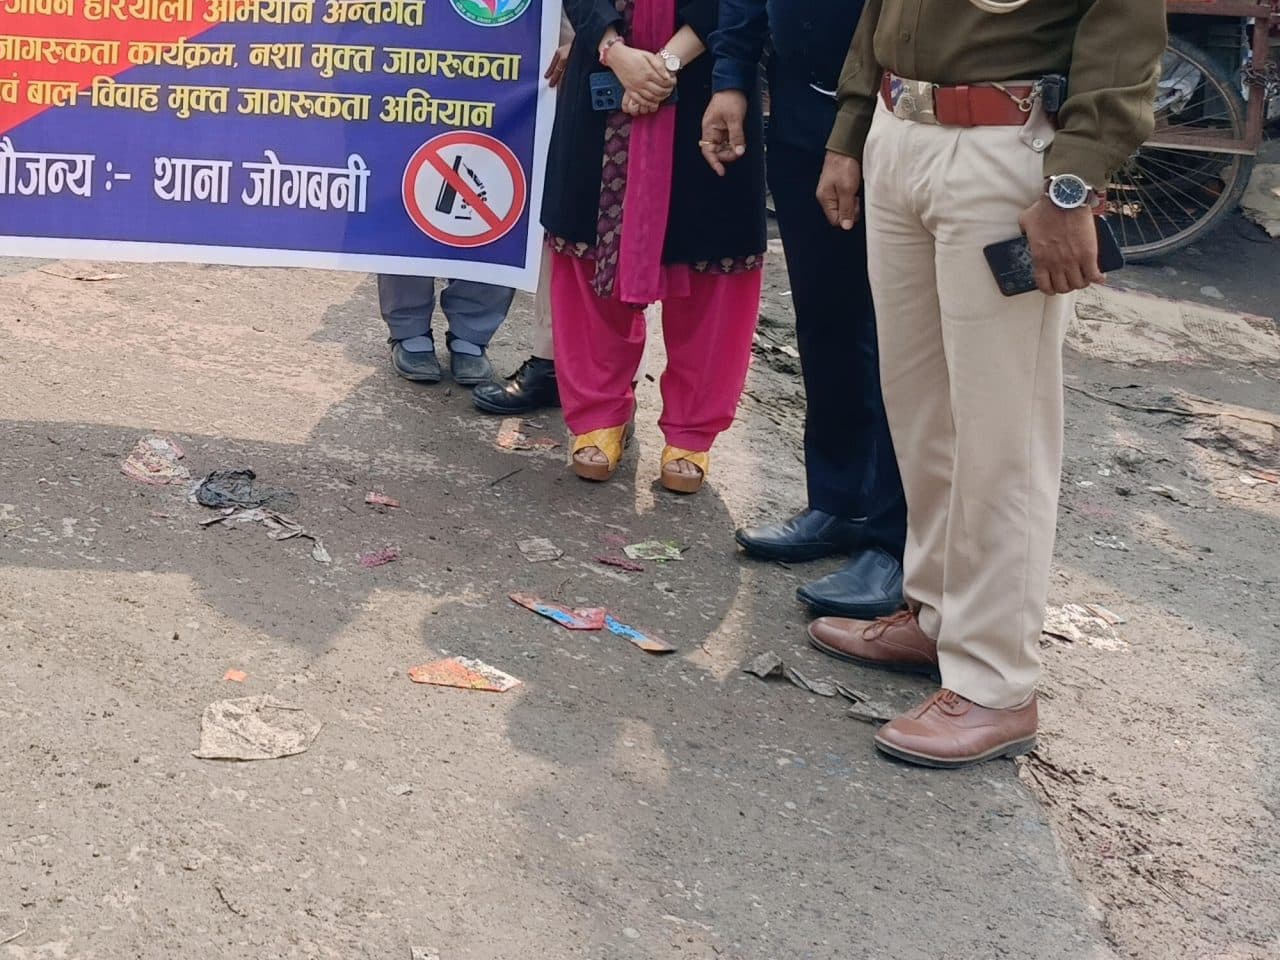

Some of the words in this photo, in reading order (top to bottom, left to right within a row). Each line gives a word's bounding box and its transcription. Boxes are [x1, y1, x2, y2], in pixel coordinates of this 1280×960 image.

[127, 35, 238, 70] कार्यक्रम,
[249, 42, 305, 70] नशा
[310, 42, 375, 78] मुक्त
[382, 46, 522, 81] जागरूकता
[26, 76, 161, 112] बाल-विवाह
[168, 84, 230, 120] मुक्त
[237, 87, 372, 122] जागरूकता
[379, 87, 496, 129] अभियान
[154, 156, 233, 204] थाना
[241, 149, 371, 214] जोगबनी
